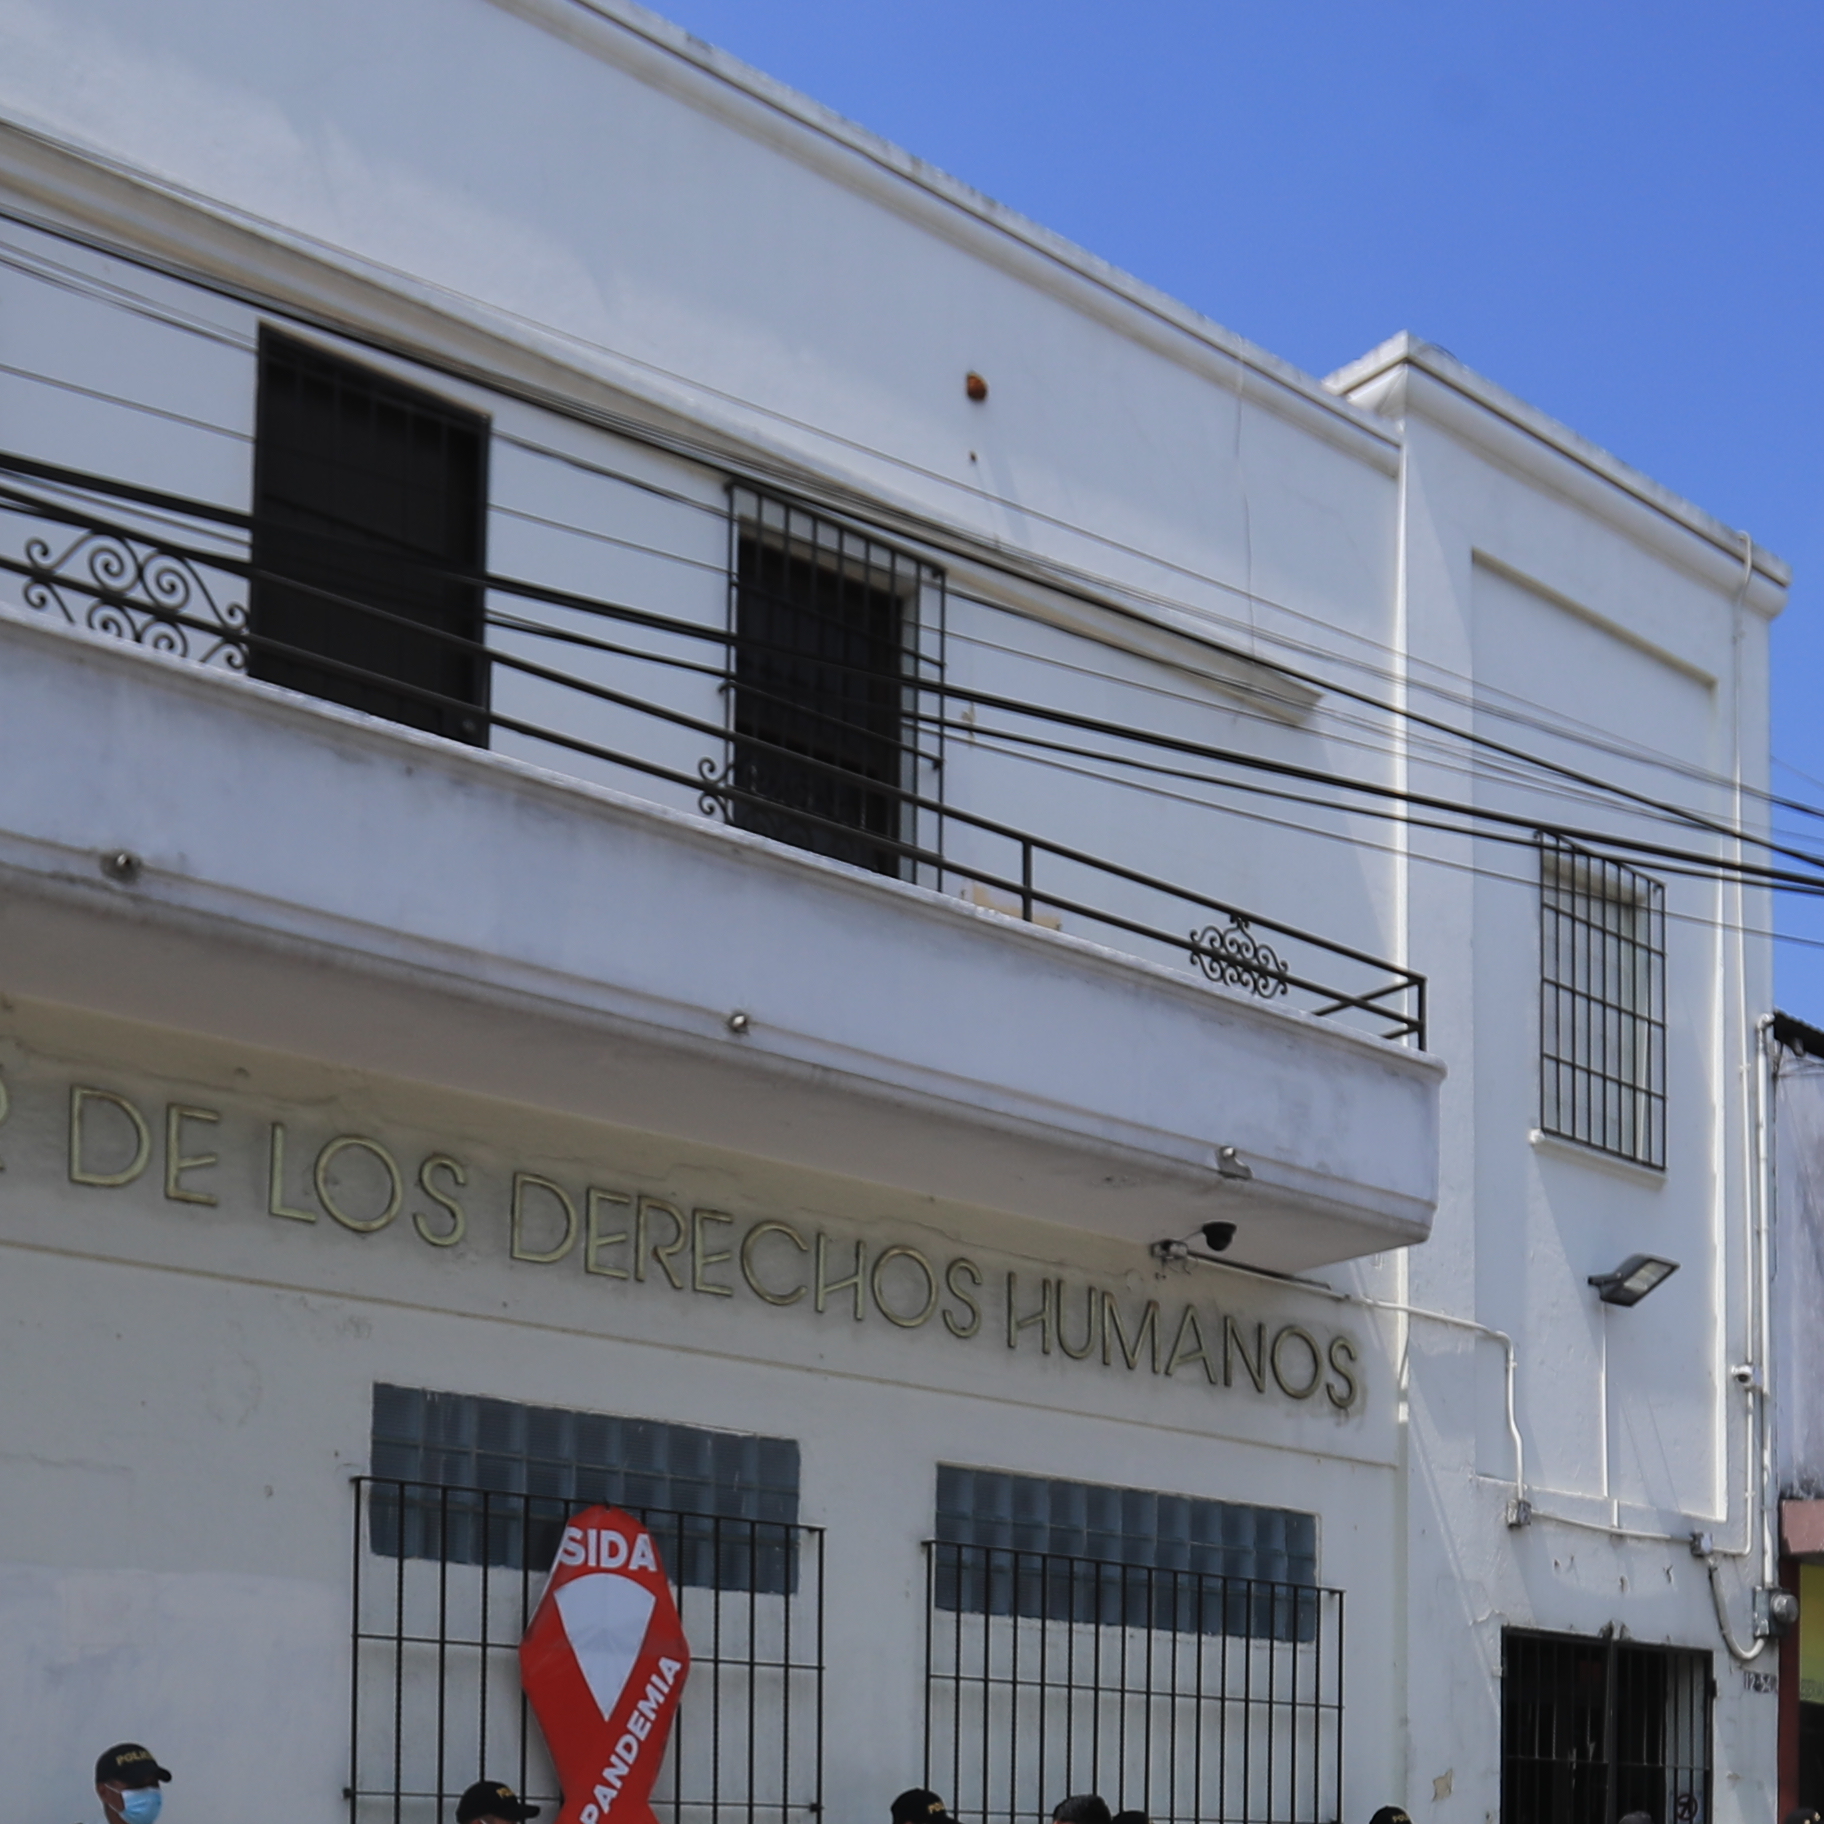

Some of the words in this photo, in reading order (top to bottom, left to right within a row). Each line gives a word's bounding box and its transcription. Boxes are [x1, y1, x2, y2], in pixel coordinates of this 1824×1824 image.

[68, 1086, 220, 1206] DE
[269, 1122, 468, 1246] LOS
[510, 1172, 982, 1340] DERECHOS
[1006, 1271, 1362, 1410] HUMANOS
[558, 1526, 658, 1572] SIDA
